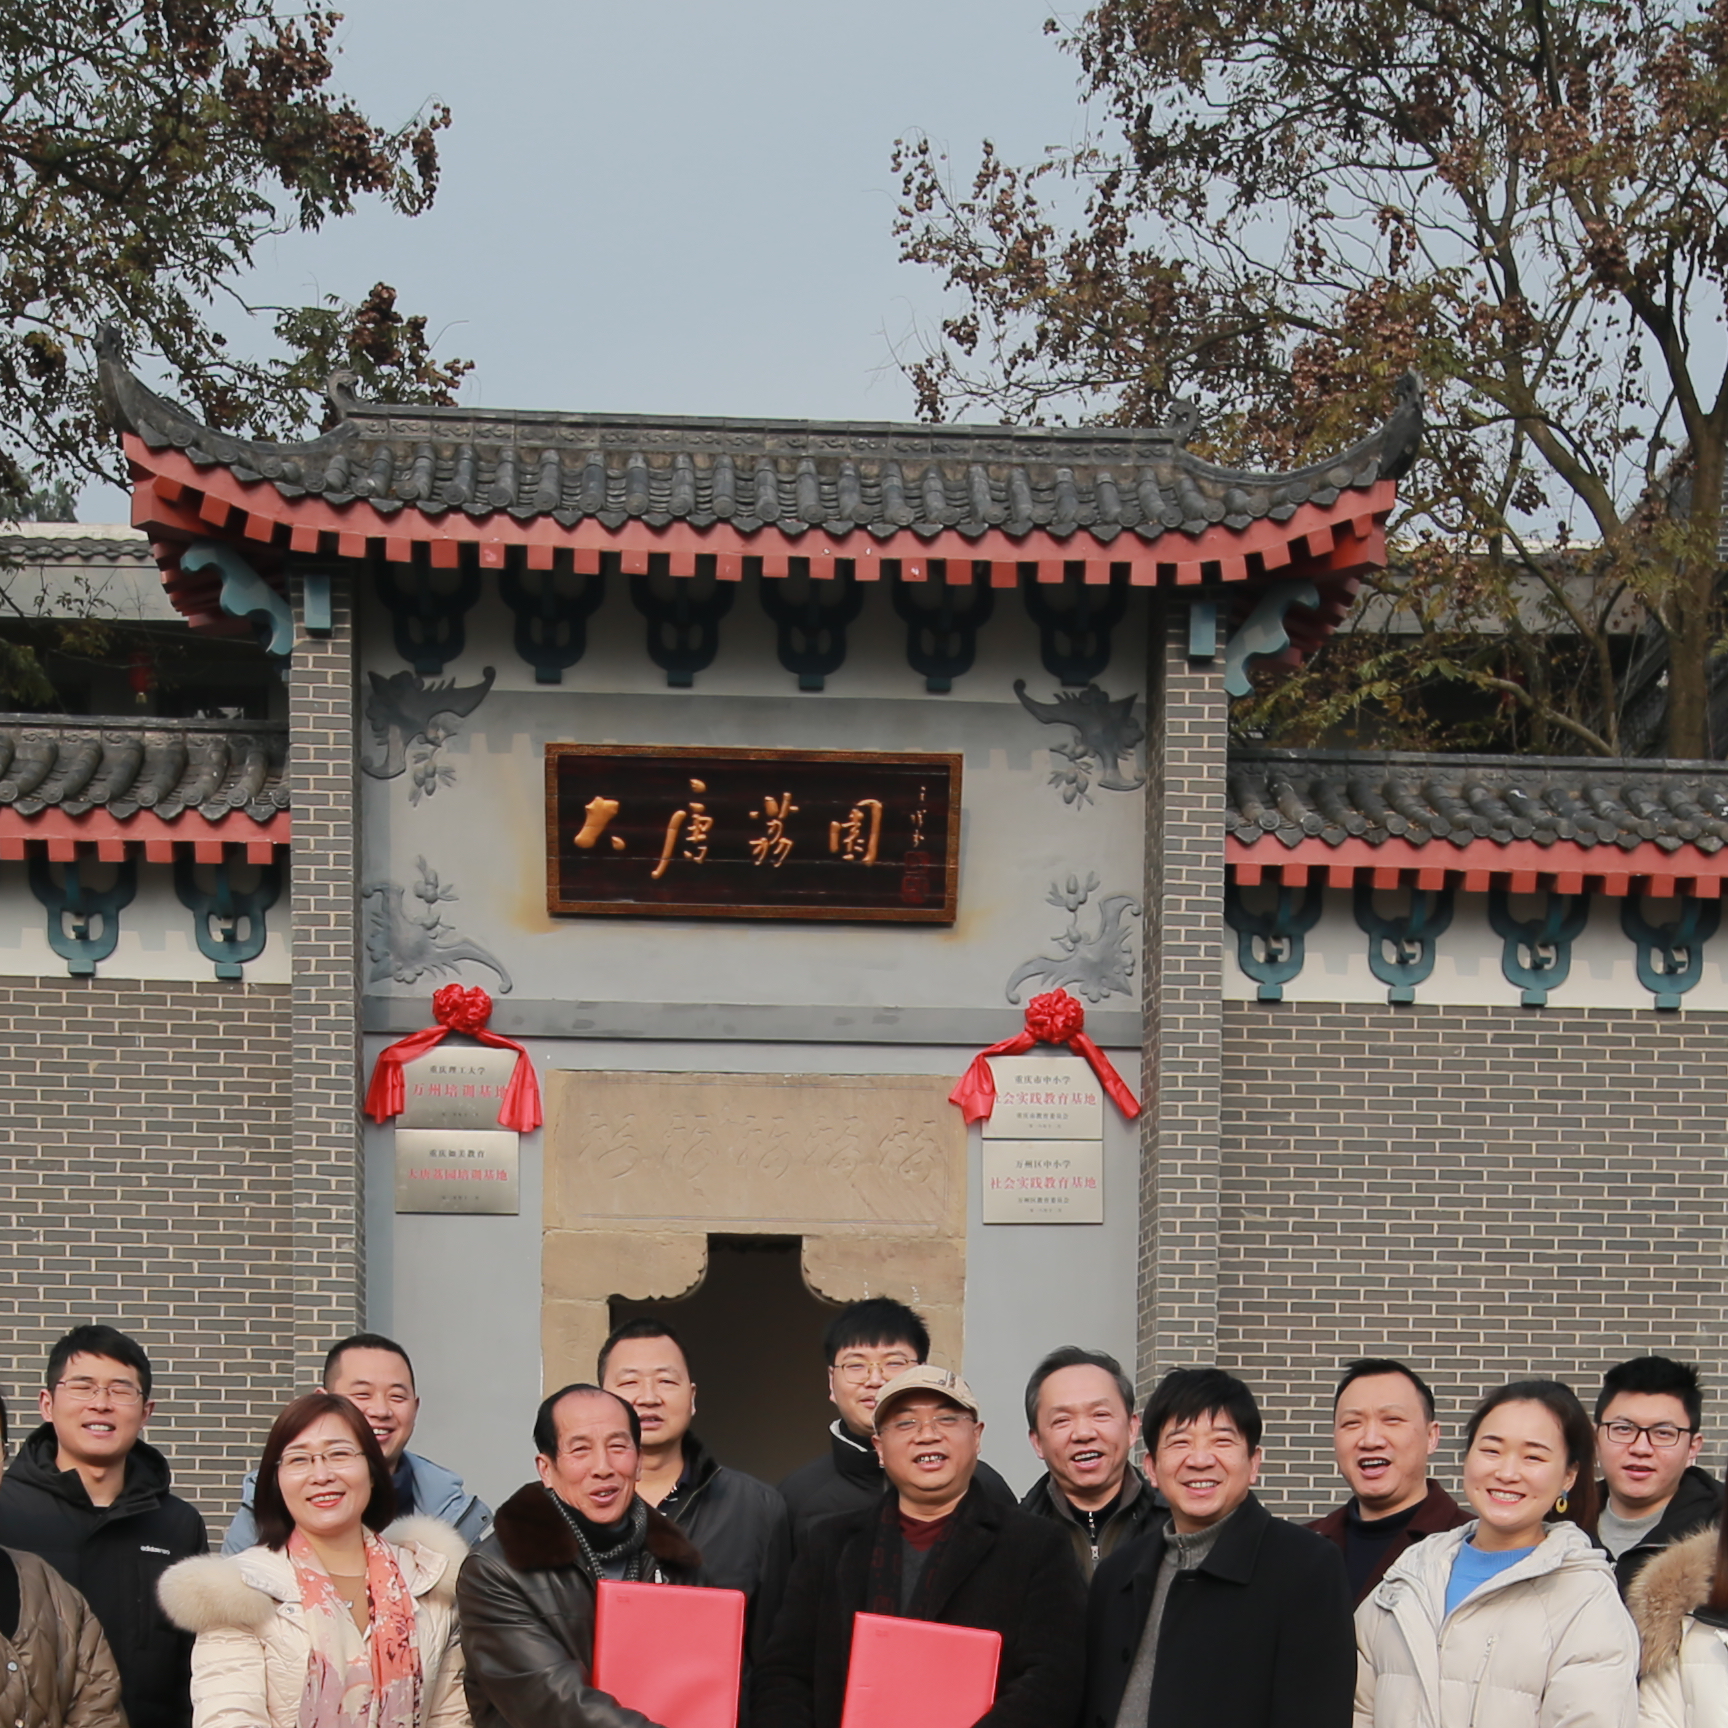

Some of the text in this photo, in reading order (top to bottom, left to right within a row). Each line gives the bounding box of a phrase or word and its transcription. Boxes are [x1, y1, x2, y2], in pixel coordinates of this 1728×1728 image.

[429, 1065, 486, 1075] 重庆理工大学
[1014, 1075, 1071, 1085] 重庆市中小学
[412, 1083, 509, 1099] 万州培训基地
[1015, 1160, 1071, 1169] 万州区中小学
[408, 1168, 508, 1182] 大唐荔园培训基地
[990, 1176, 1097, 1190] 社会实践教育基地
